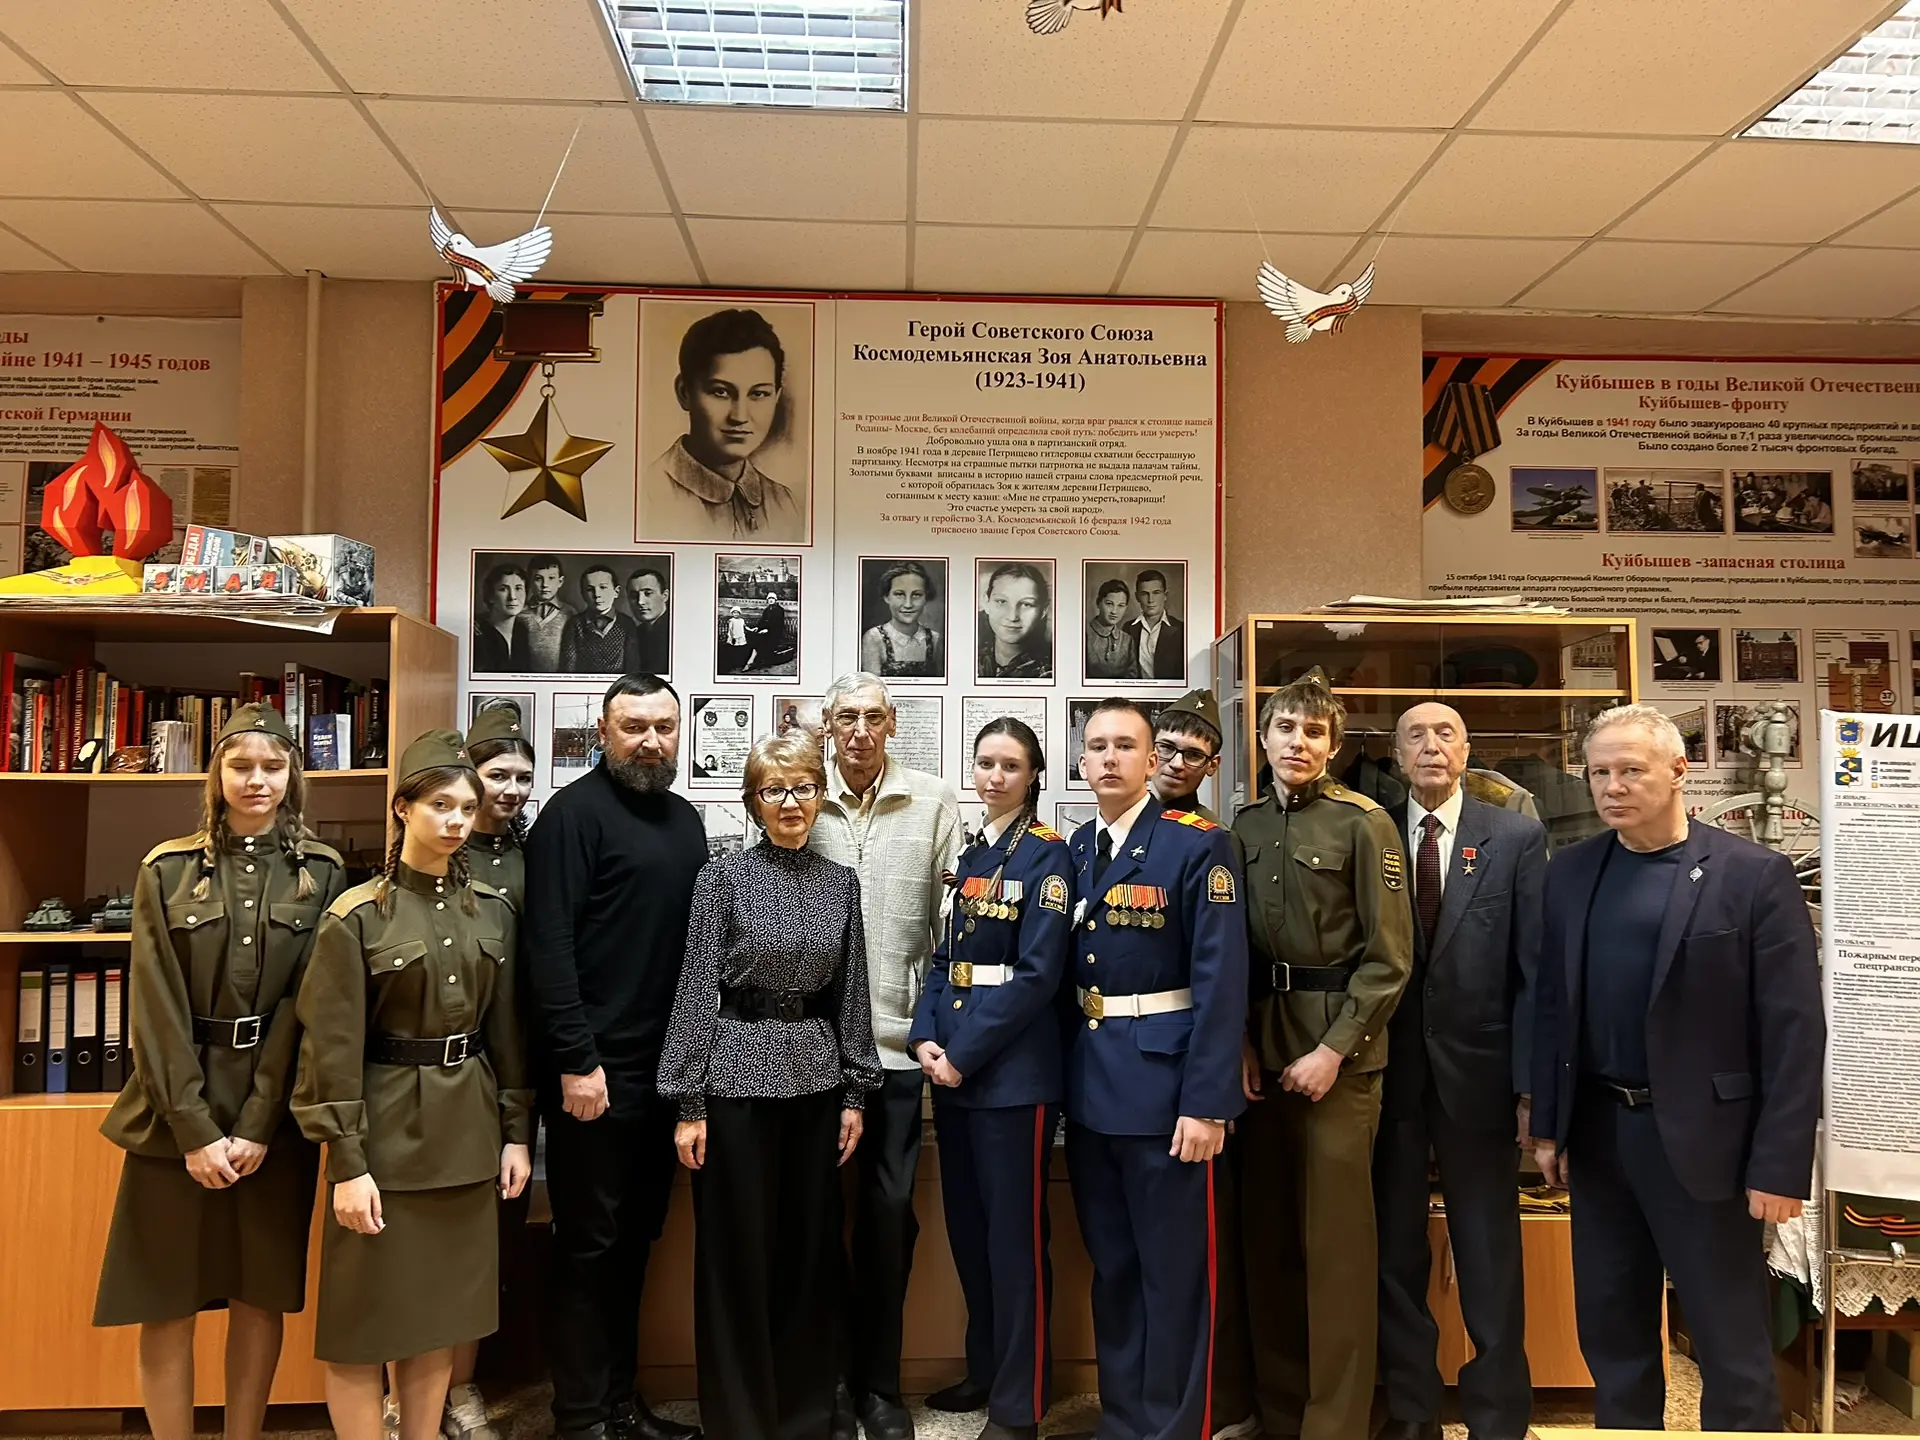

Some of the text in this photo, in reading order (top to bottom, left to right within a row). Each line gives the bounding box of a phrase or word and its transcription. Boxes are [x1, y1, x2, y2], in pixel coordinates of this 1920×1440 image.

[908, 319, 1153, 341] Герой Советского Союза
[43, 352, 82, 368] 1941
[110, 353, 152, 369] 1945
[157, 358, 210, 370] годов
[854, 344, 1206, 366] Космодемьянская Зоя Анатольевна
[975, 371, 1086, 392] (1923-1941)
[1556, 373, 1656, 393] Куйбышев
[1660, 379, 1672, 390] в
[1676, 379, 1720, 392] годы
[1725, 376, 1804, 392] Великой
[49, 407, 130, 425] Германии
[840, 411, 855, 421] Зоя
[864, 414, 901, 423] грозные
[902, 415, 920, 423] дни
[921, 412, 958, 422] Великой
[959, 413, 1026, 423] Отечественной
[1028, 414, 1060, 424] войны,
[1061, 417, 1085, 425] когда
[1086, 417, 1107, 426] враг
[1108, 417, 1138, 426] рвался
[1146, 418, 1182, 426] столице
[1184, 416, 1212, 426] нашей
[1537, 415, 1594, 429] Куйбышев
[1606, 416, 1629, 427] 1941
[1632, 420, 1656, 430] году
[1658, 417, 1688, 428] было
[1690, 420, 1765, 431] эвакуировано
[1782, 422, 1828, 432] крупных
[1830, 420, 1899, 433] предприятий
[855, 423, 892, 434] Родины-
[894, 424, 931, 434] Москве,
[932, 424, 947, 434] без
[949, 424, 996, 434] колебаний
[997, 427, 1048, 437] определила
[1049, 425, 1070, 435] свой
[1072, 428, 1096, 437] путь:
[1097, 426, 1138, 437] победить
[1159, 427, 1197, 439] умереть!
[1531, 430, 1558, 439] годы
[1561, 428, 1607, 438] Великой
[1608, 428, 1690, 439] Отечественной
[1692, 429, 1728, 440] войны
[1740, 430, 1754, 441] 7,1
[1757, 433, 1782, 443] раза
[1784, 433, 1854, 444] увеличилось
[1856, 434, 1920, 444] промышлен
[925, 435, 985, 448] Добровольно
[986, 439, 1010, 448] ушла
[1037, 437, 1097, 449] партизанский
[1099, 440, 1126, 450] отряд.
[1638, 440, 1668, 451] Было
[1670, 443, 1714, 452] создано
[1716, 441, 1749, 452] более
[1760, 444, 1793, 452] тысяч
[1795, 442, 1857, 456] фронтовых
[1859, 443, 1898, 456] бригад.
[866, 445, 897, 457] ноябре
[900, 446, 918, 455] 1941
[922, 448, 942, 456] года
[950, 449, 986, 458] деревне
[988, 447, 1038, 459] Петрищево
[1040, 450, 1092, 459] гитлеровцы
[1135, 449, 1196, 461] бесстрашную
[892, 515, 920, 524] отвагу
[931, 513, 976, 525] геройство
[978, 514, 995, 523] З.А.
[997, 514, 1076, 525] Космодемьянской
[1090, 515, 1127, 527] февраля
[1130, 516, 1150, 525] 1942
[1152, 518, 1171, 526] года
[930, 525, 1118, 537] присвоено звание Героя Советского Союза.
[184, 532, 201, 566] ОБЕДА!
[1602, 552, 1691, 571] Куйбышев
[1779, 558, 1844, 571] столица
[153, 572, 169, 590] 9
[1838, 950, 1897, 961] Пожарным
